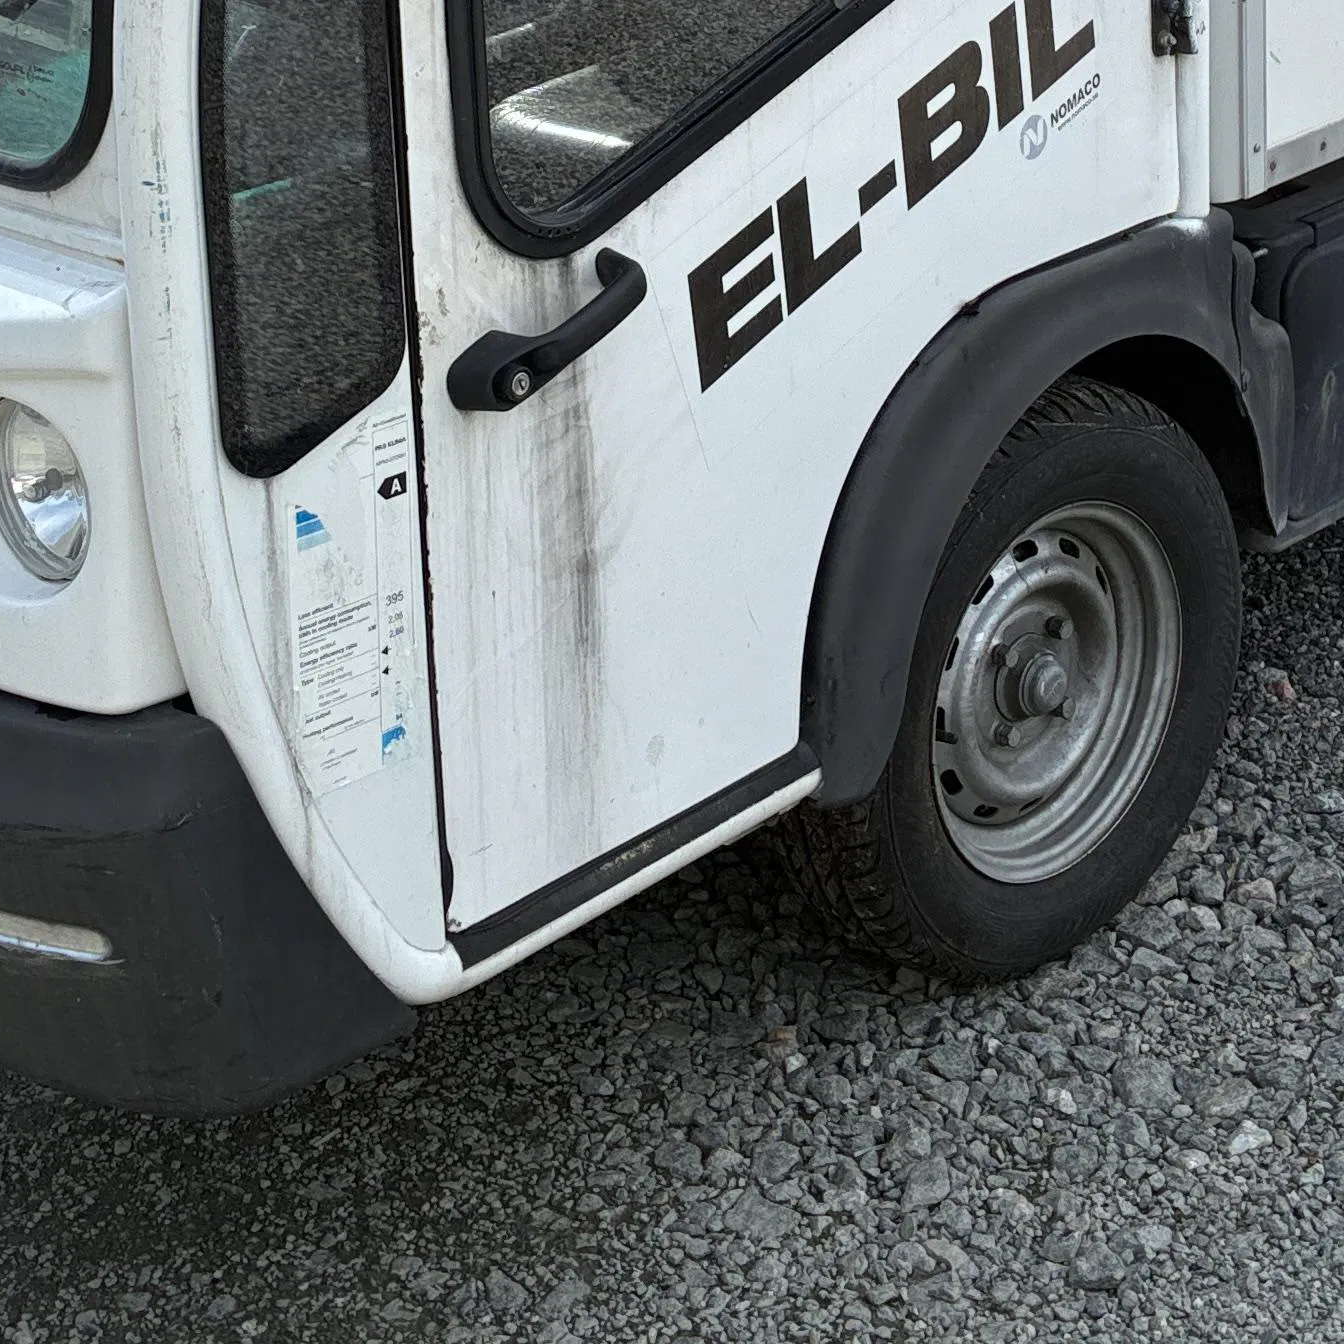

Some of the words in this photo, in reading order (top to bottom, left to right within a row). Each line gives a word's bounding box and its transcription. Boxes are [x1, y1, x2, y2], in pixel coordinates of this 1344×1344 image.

[1050, 73, 1100, 128] NOMACO
[391, 478, 402, 495] A
[386, 590, 404, 607] 395
